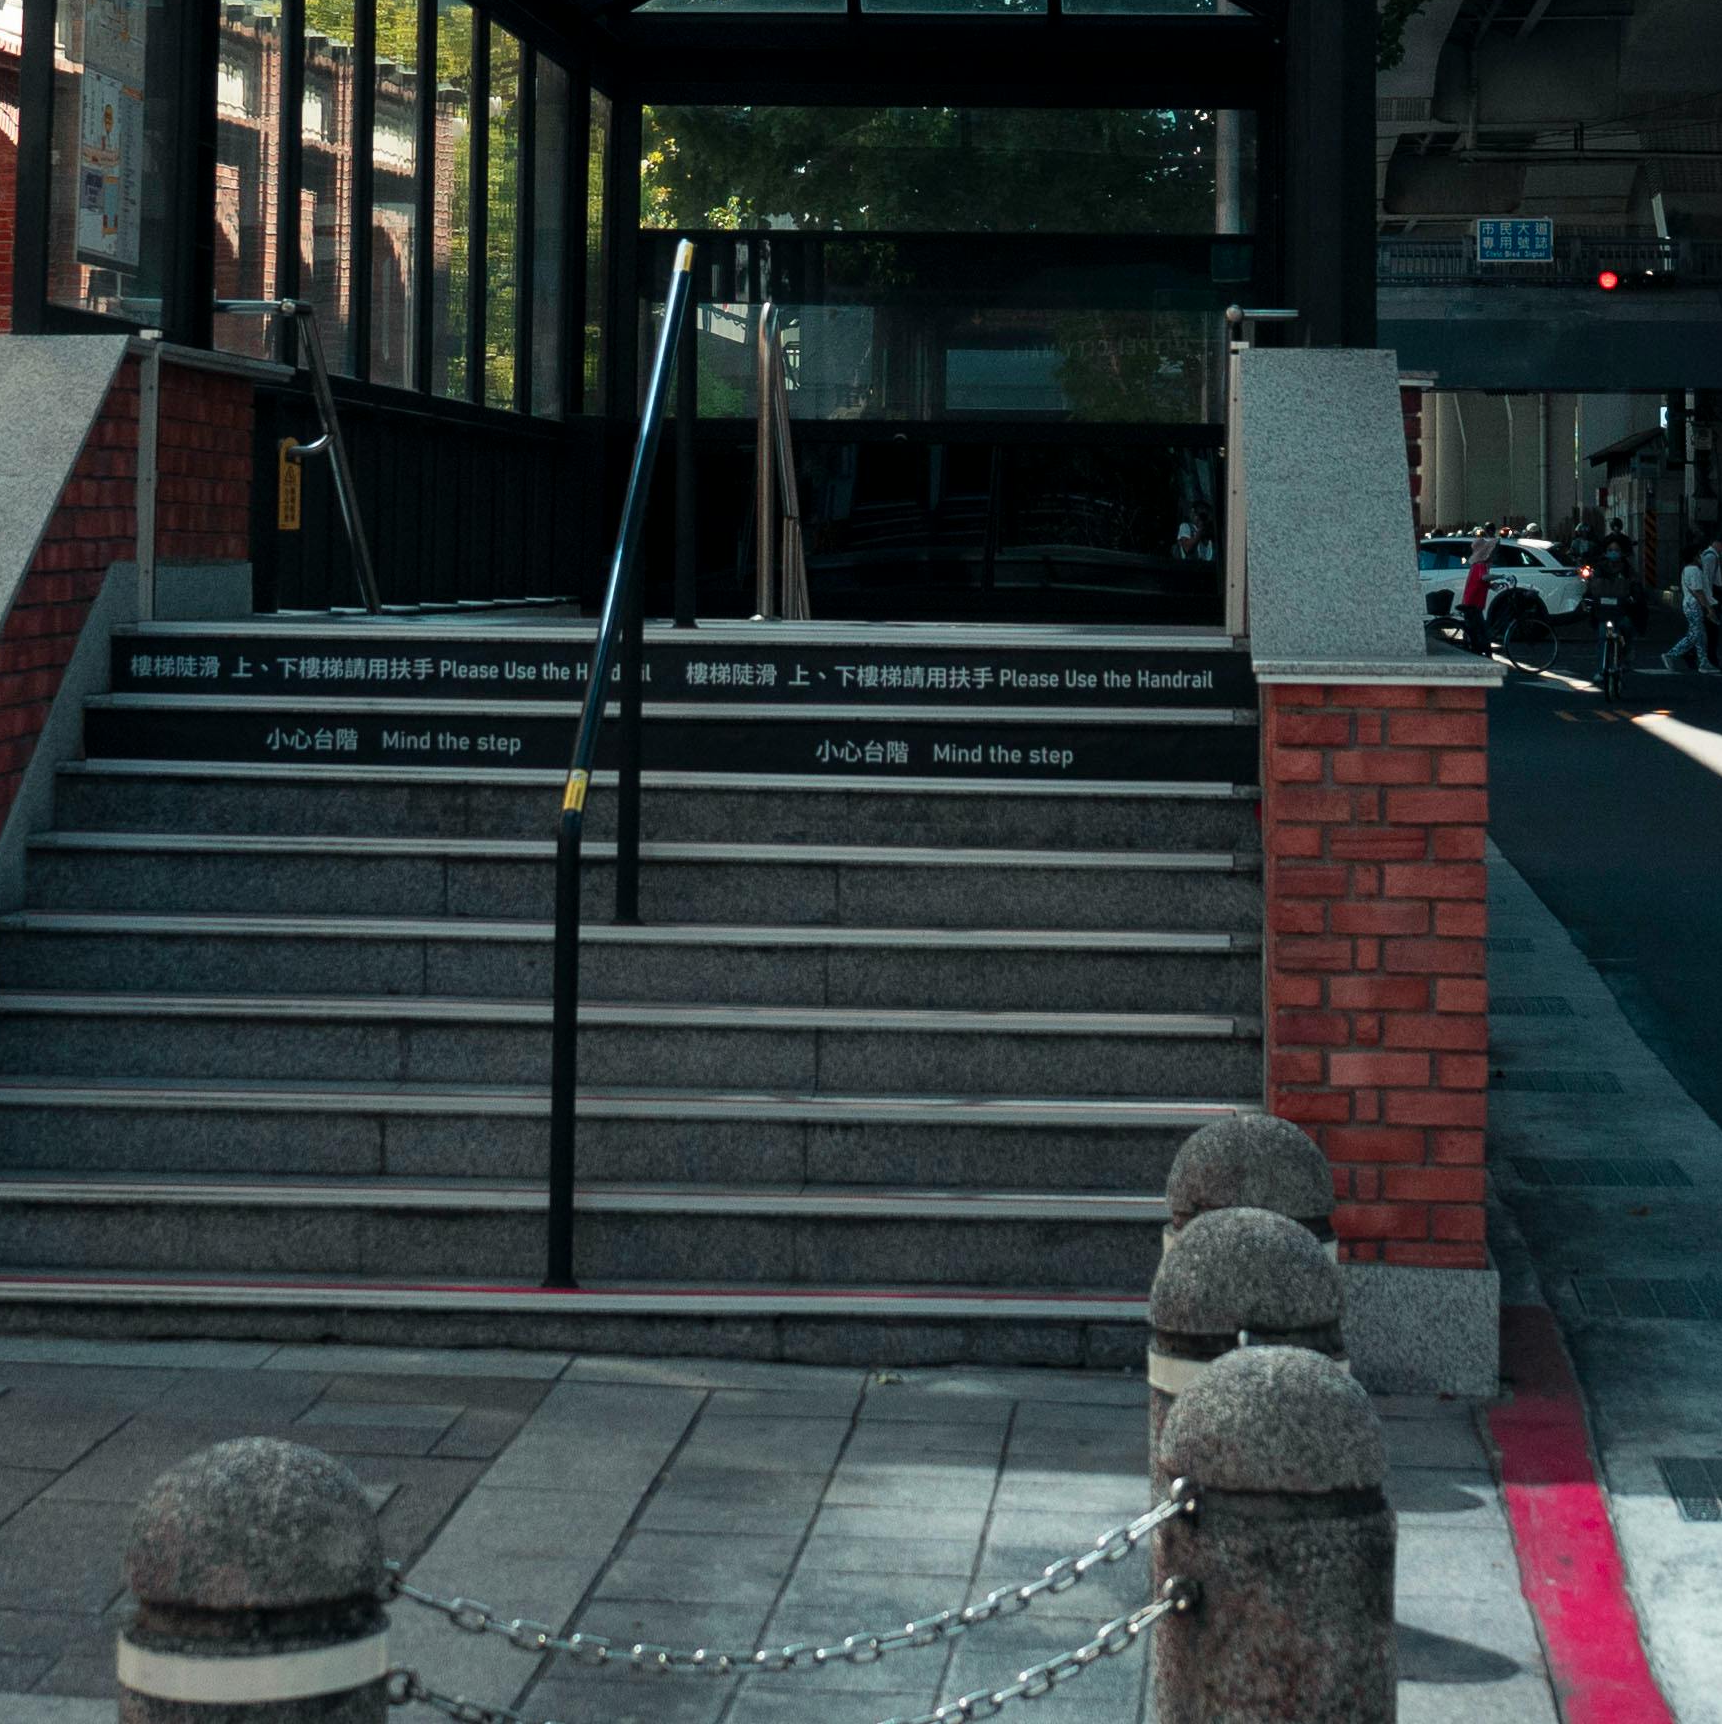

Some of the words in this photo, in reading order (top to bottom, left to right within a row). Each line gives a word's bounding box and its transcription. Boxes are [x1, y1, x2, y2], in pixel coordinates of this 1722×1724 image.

[1482, 222, 1548, 236] 市民大道
[130, 656, 221, 679] 樓梯陡滑
[231, 656, 434, 681] 上、下樓梯請用扶手
[439, 659, 499, 679] Please
[504, 660, 536, 680] Use
[541, 660, 570, 680] the
[685, 662, 777, 686] 樓梯陡滑
[787, 664, 995, 690] 上、下樓梯請用扶手
[999, 668, 1060, 689] Please
[1065, 669, 1098, 689] Use
[1102, 669, 1132, 689] the
[1136, 669, 1214, 690] Handrail
[266, 727, 359, 752] 小心台階
[382, 731, 431, 751] Mind
[437, 731, 470, 752] the
[476, 733, 522, 756] step
[815, 739, 909, 765] 小心台階
[933, 744, 982, 764] Mind
[988, 744, 1022, 765] the
[1029, 746, 1074, 769] step
